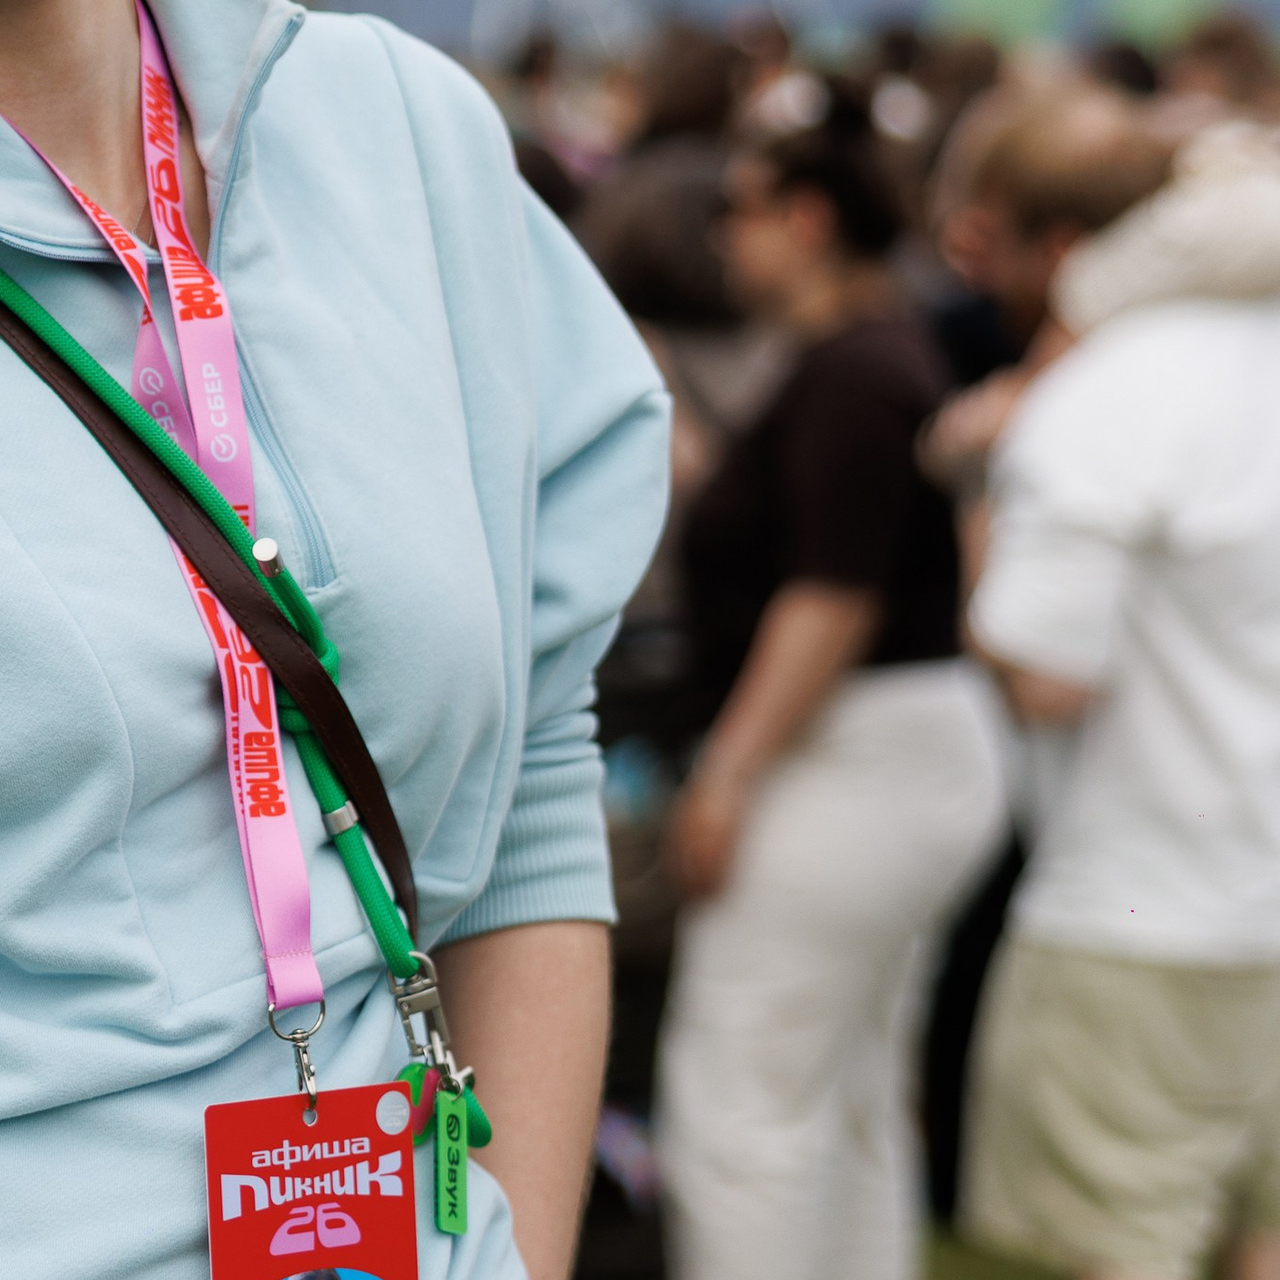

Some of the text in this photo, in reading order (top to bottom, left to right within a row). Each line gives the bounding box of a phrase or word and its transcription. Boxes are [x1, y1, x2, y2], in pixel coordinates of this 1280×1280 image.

[202, 362, 228, 427] СБЕР
[243, 732, 286, 817] афиша
[252, 1137, 370, 1170] афиша
[269, 1202, 361, 1256] 26
